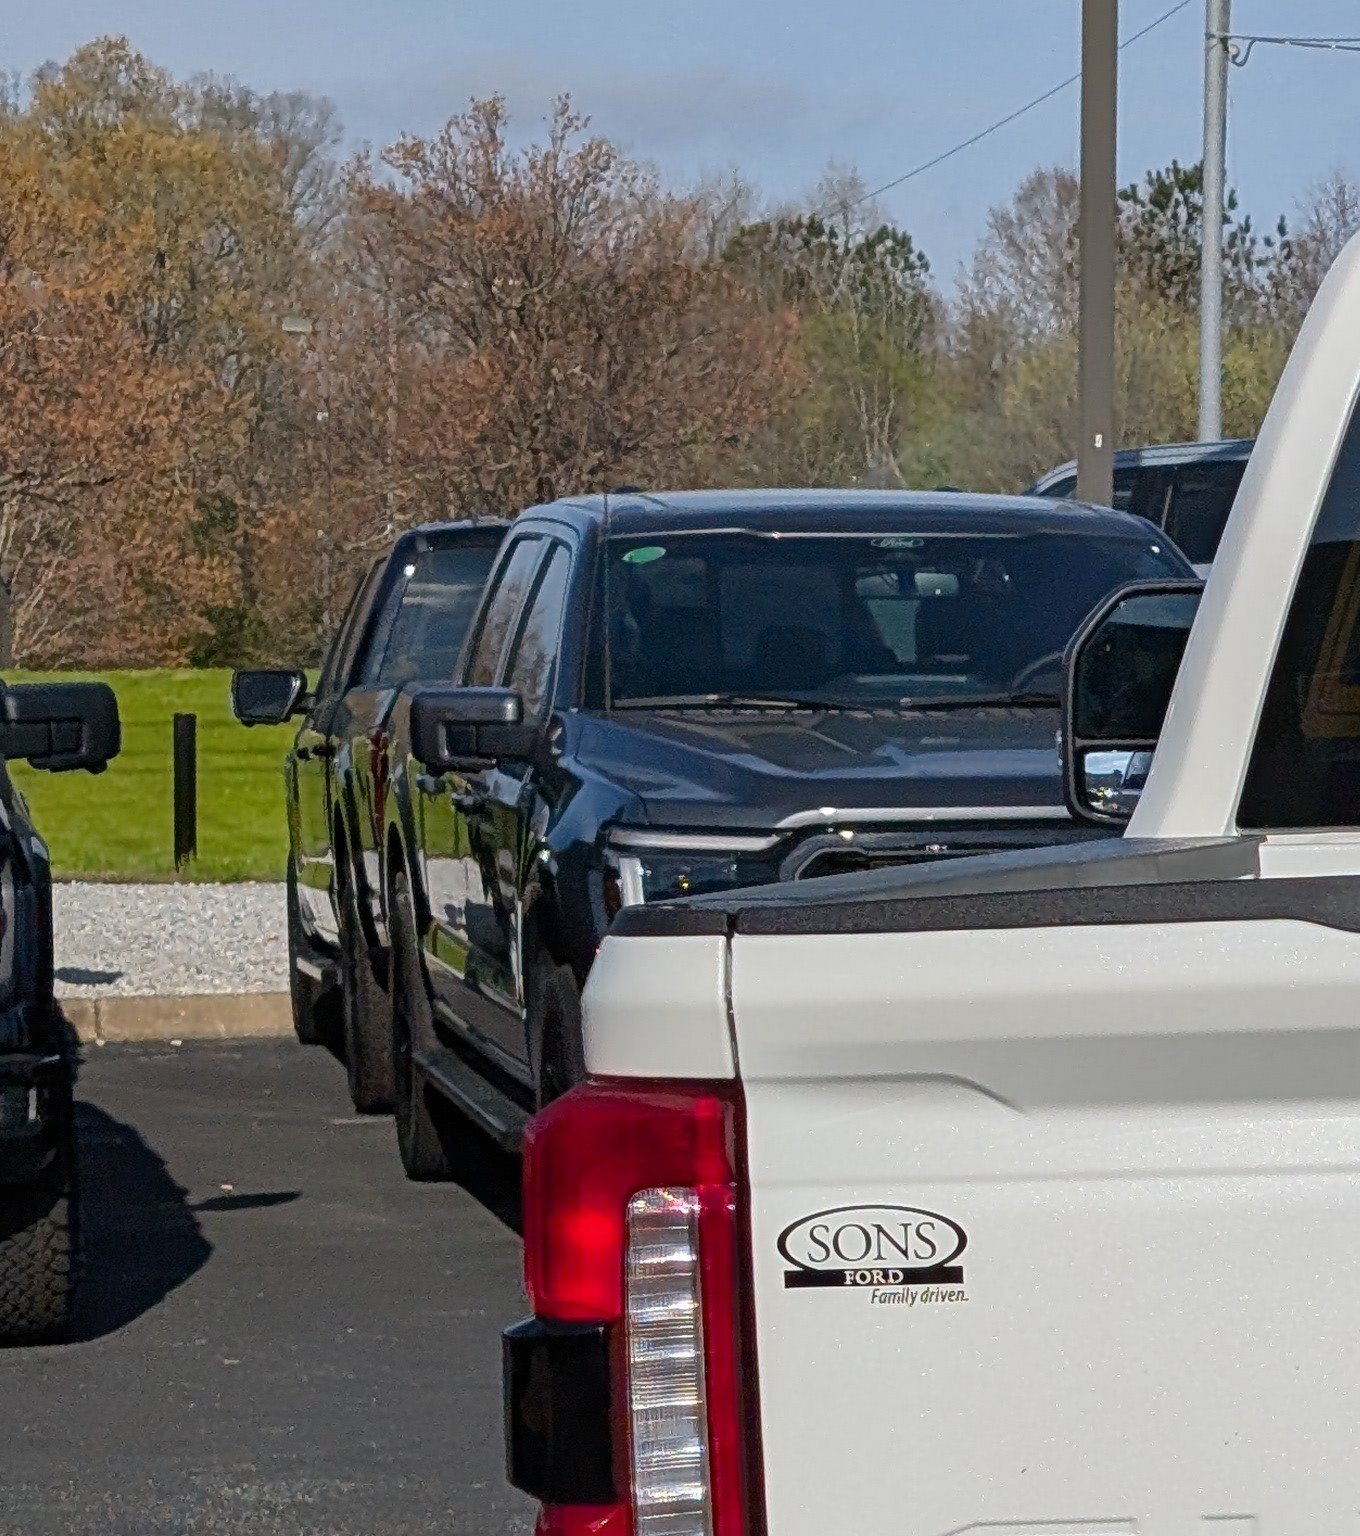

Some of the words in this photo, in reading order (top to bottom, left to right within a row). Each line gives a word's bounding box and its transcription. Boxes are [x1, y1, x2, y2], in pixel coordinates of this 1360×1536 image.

[807, 1221, 937, 1263] SONS
[843, 1269, 905, 1285] FORD
[871, 1288, 919, 1307] Family
